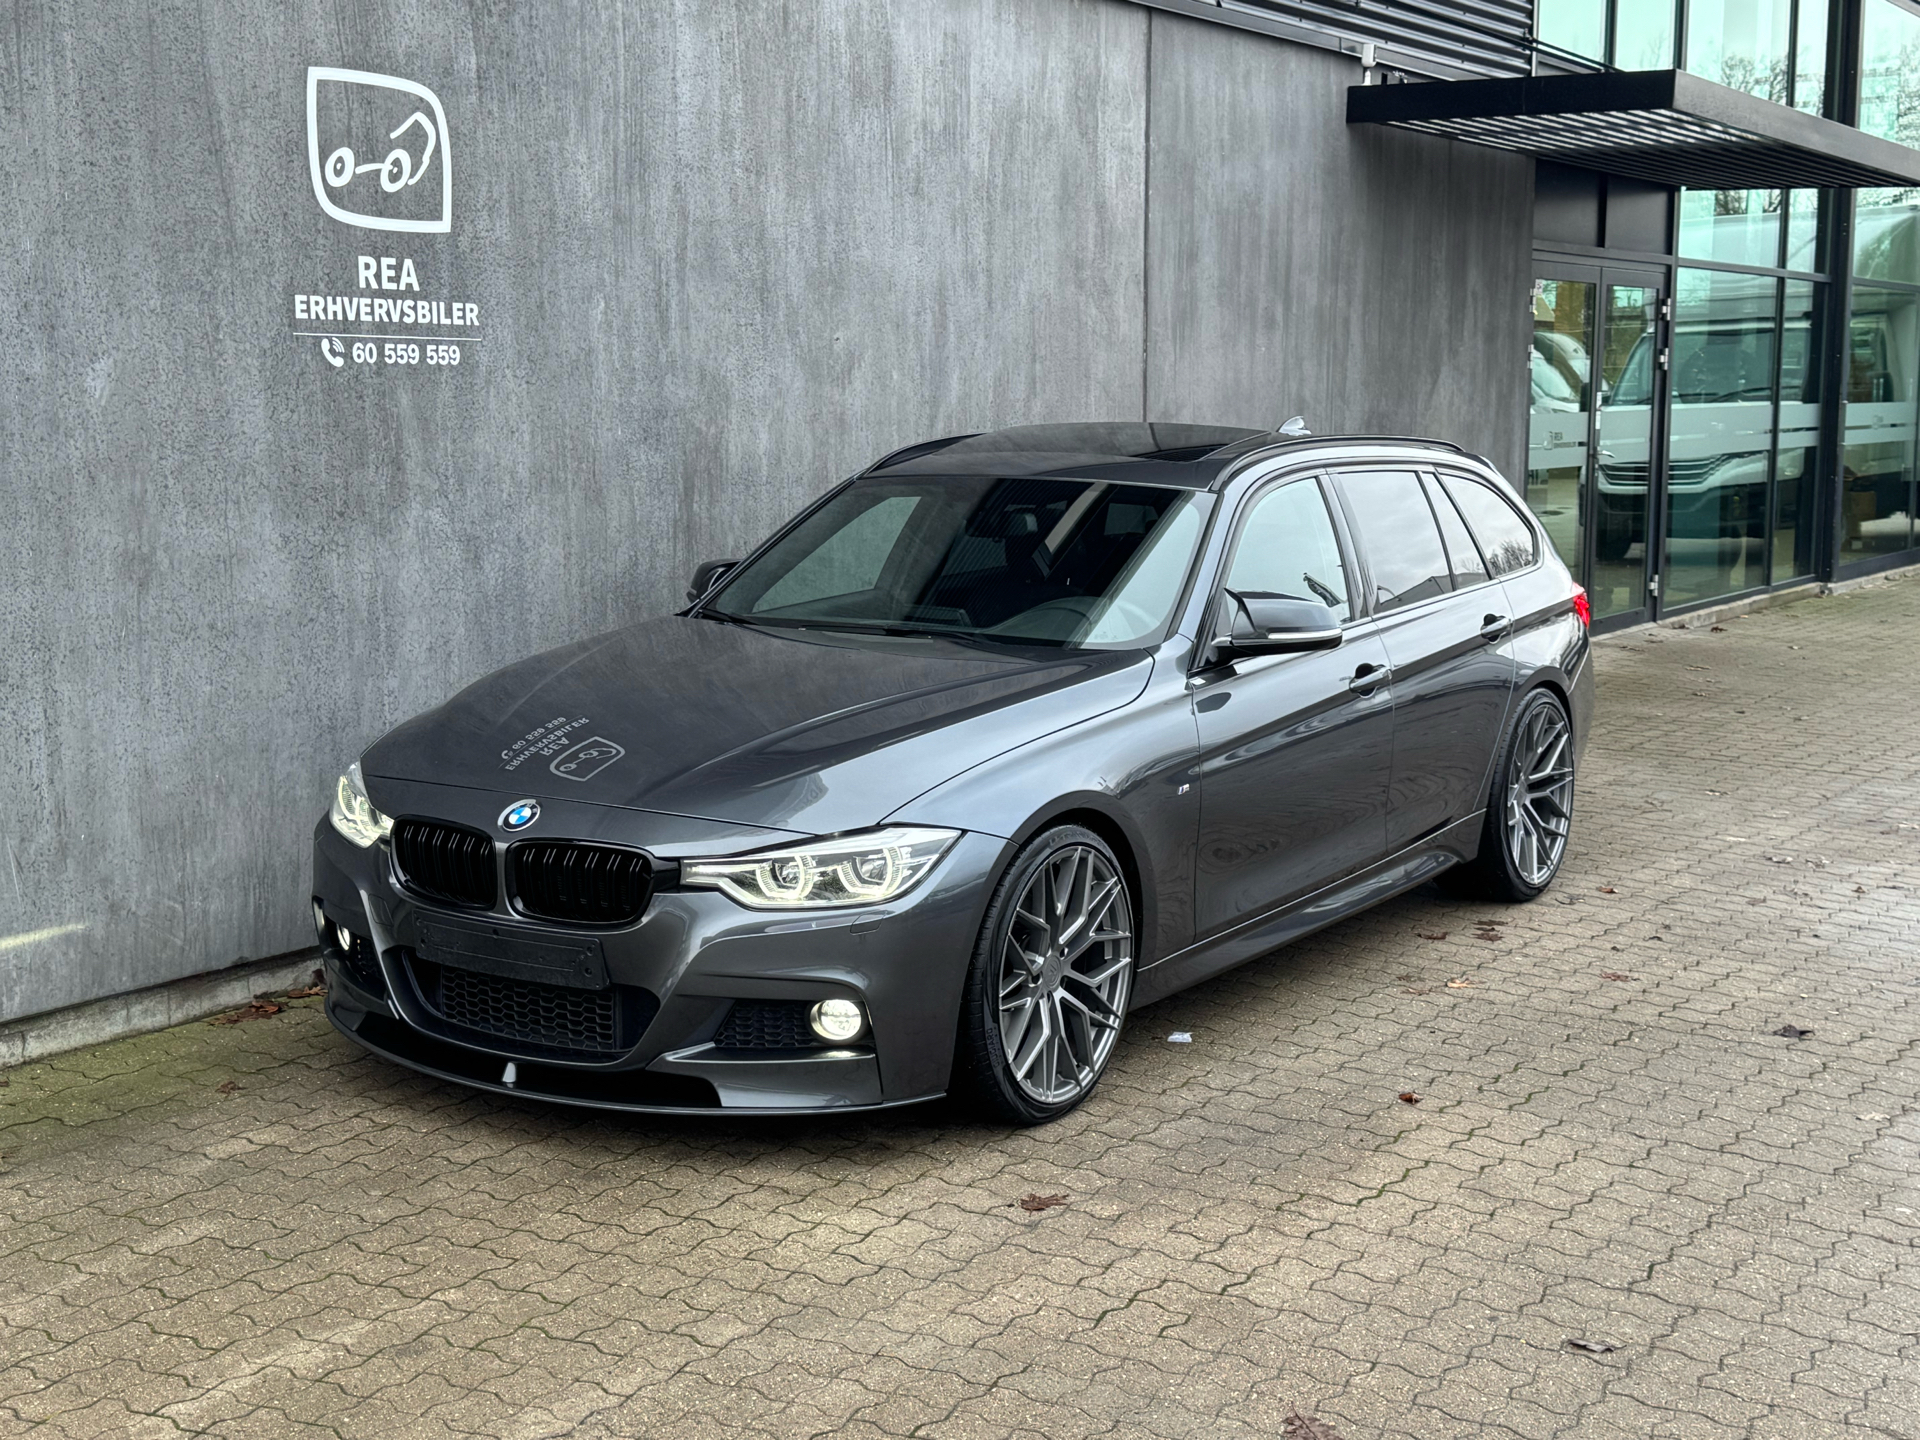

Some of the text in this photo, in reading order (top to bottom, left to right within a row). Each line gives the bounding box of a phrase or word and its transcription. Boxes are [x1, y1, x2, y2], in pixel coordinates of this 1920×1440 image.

[357, 255, 420, 292] REA
[294, 294, 480, 326] ERHVERVSBILER
[352, 342, 461, 366] 60 559 559
